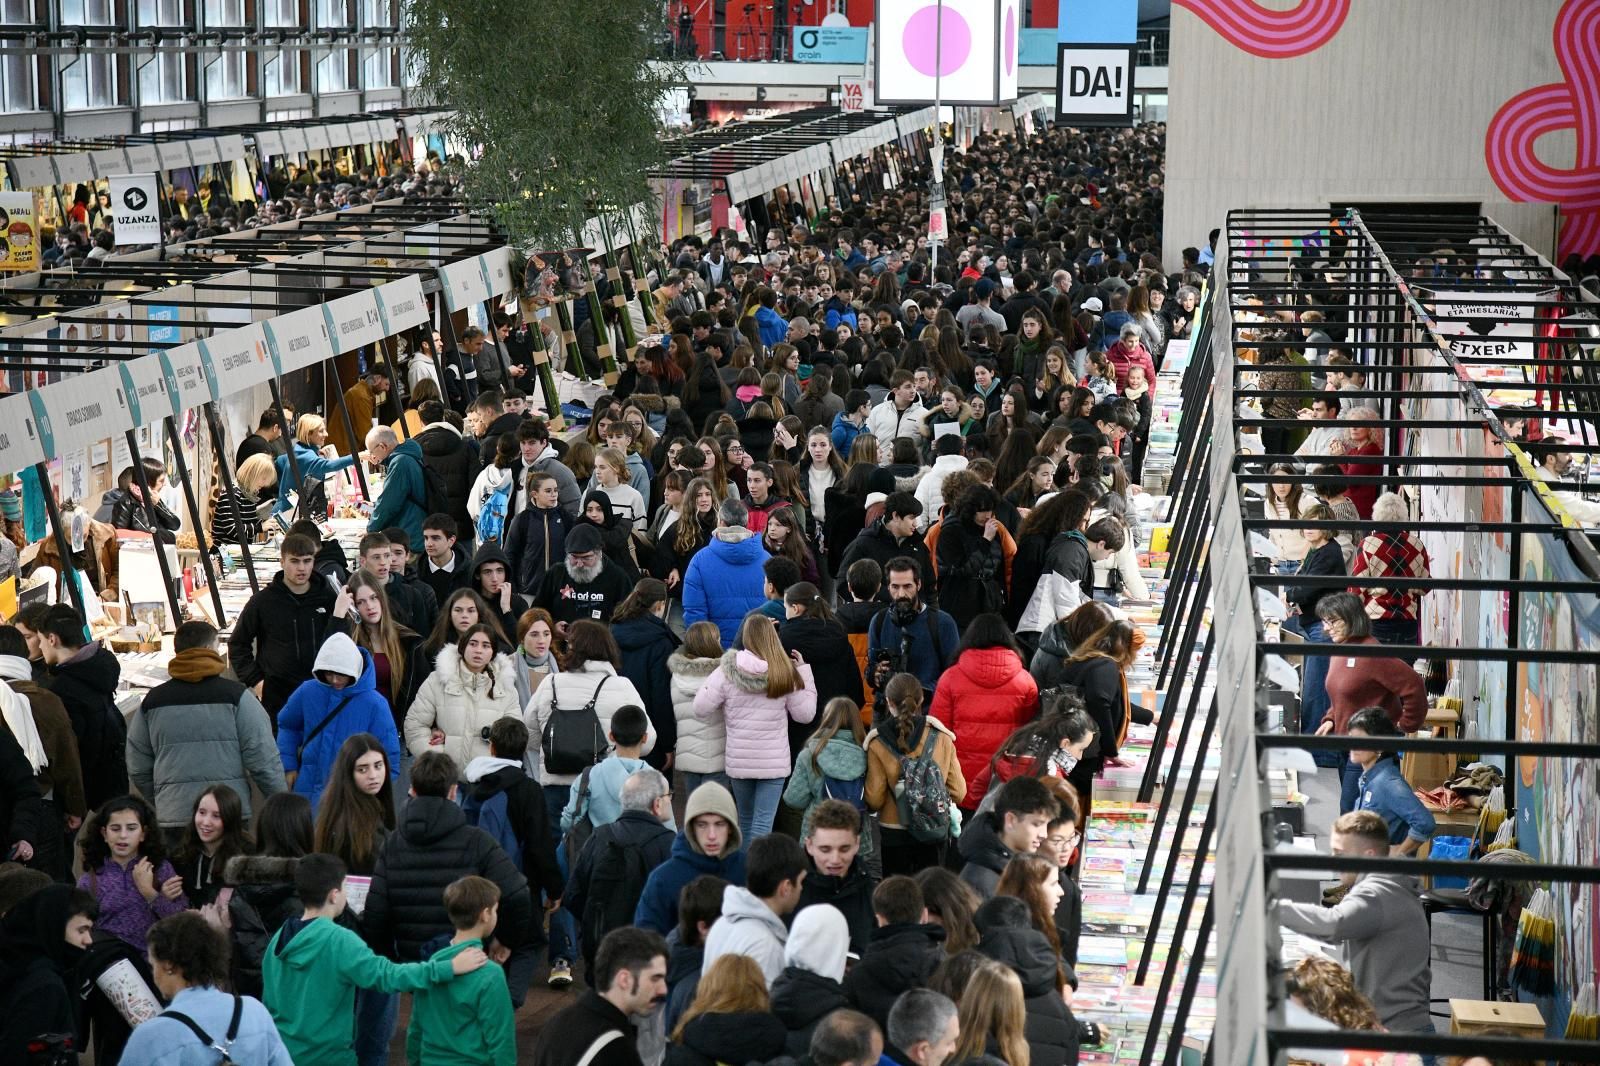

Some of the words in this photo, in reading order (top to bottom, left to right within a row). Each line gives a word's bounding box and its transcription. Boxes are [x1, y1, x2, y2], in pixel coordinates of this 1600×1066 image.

[1070, 66, 1122, 97] DA!
[844, 84, 862, 96] YA
[843, 98, 863, 109] NIZ
[118, 215, 157, 224] UZANZA
[1448, 309, 1464, 317] ETA
[1466, 308, 1520, 318] IHESLARIAK
[1449, 340, 1518, 356] ETXERA
[168, 375, 178, 391] 12
[129, 388, 138, 405] 11
[41, 416, 51, 434] 10
